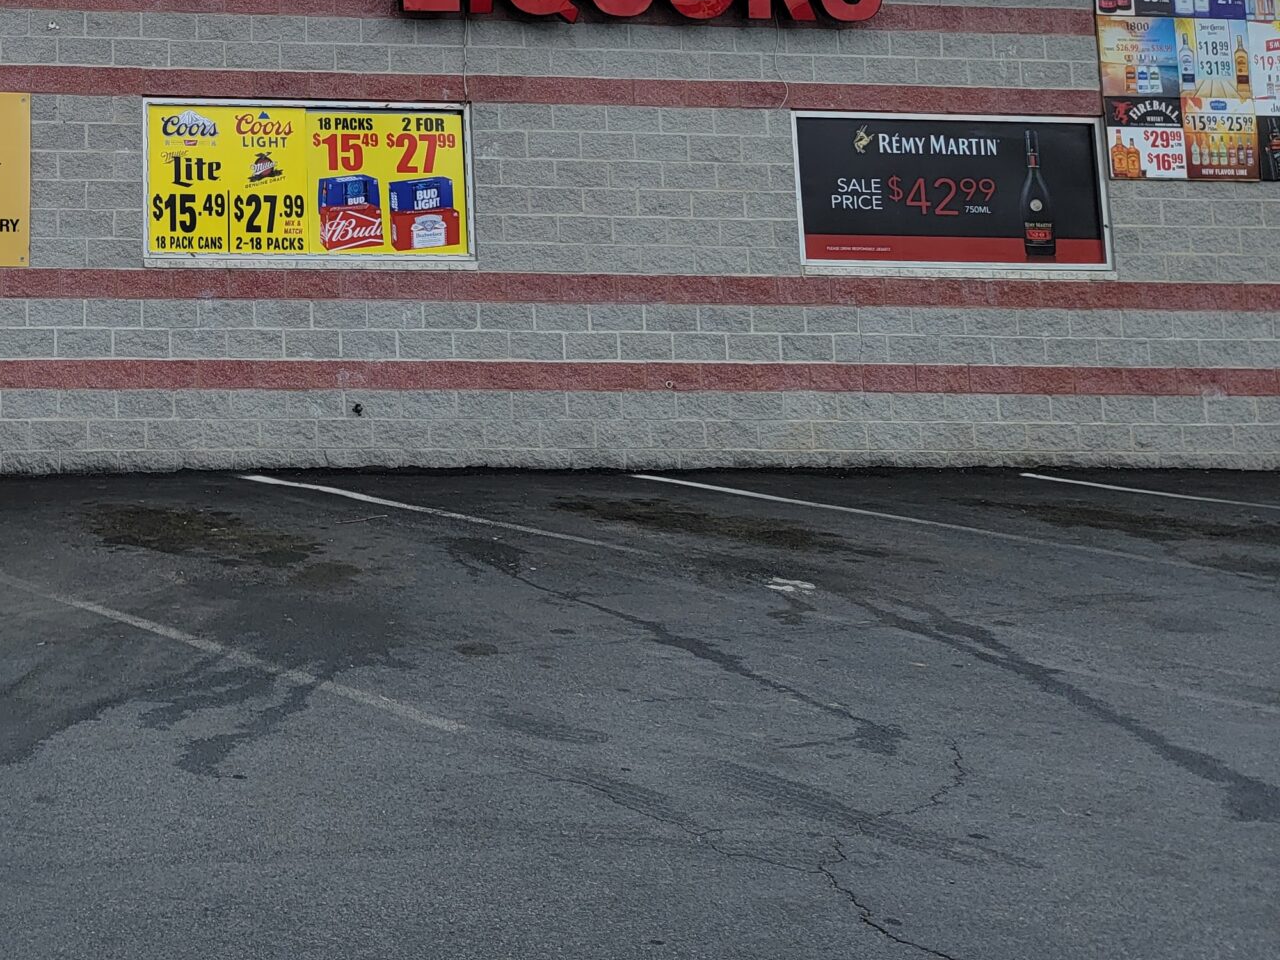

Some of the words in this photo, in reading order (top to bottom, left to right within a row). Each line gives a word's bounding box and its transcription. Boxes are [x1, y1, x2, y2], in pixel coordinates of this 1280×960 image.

[1126, 21, 1149, 31] 1800
[1129, 100, 1179, 121] FIREBALL
[161, 115, 218, 136] Coors
[235, 113, 294, 136] Coors
[318, 117, 331, 130] 18
[335, 118, 373, 131] PACKS
[401, 117, 412, 132] 2
[415, 118, 445, 132] FOR
[242, 136, 288, 148] LIGHT
[878, 132, 926, 154] RÉMY
[930, 134, 998, 156] MARTIN
[172, 156, 221, 188] Lite
[245, 180, 268, 189] GENUINE
[269, 175, 287, 184] DRAFT
[837, 177, 882, 193] SALE
[348, 196, 365, 205] BUD
[416, 189, 438, 200] BUD
[414, 197, 440, 210] LIGHT
[831, 194, 883, 210] PRICE
[152, 194, 225, 234] $15.49
[234, 194, 305, 234] $27.99
[964, 206, 992, 214] 750ML
[284, 219, 295, 227] MIX
[283, 227, 303, 235] MATCH
[155, 236, 166, 249] 18
[170, 236, 194, 249] PACK
[198, 236, 223, 250] CANS
[235, 237, 262, 251] 2-18
[266, 237, 304, 251] PACKS
